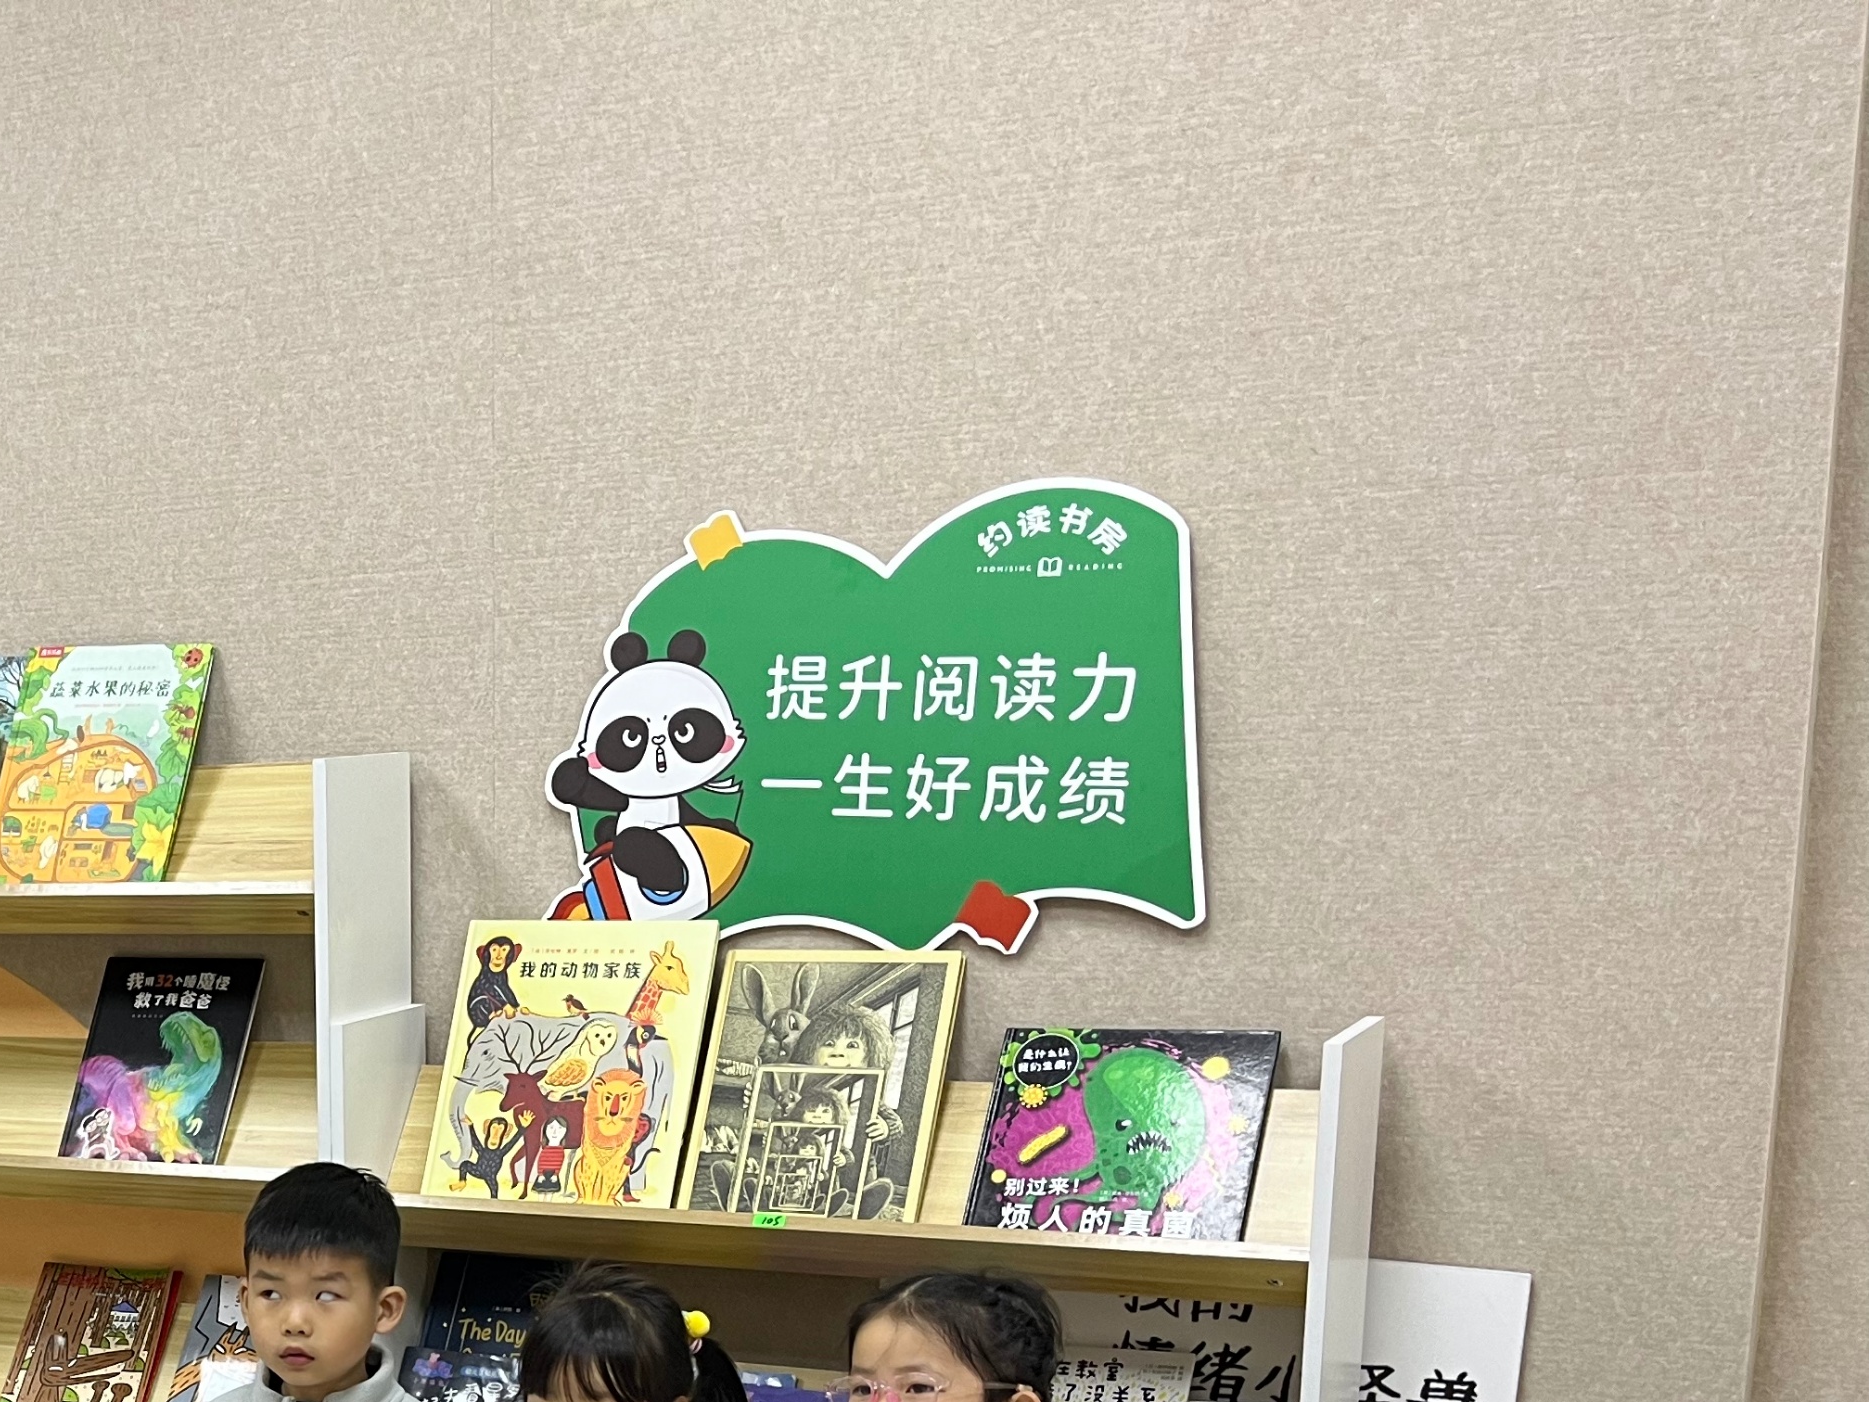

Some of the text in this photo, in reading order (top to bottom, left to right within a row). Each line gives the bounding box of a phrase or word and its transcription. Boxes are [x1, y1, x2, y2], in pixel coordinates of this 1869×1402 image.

[977, 502, 1128, 558] 约读书房
[976, 562, 1123, 573] PROMISING READING
[50, 680, 171, 698] 蔬菜水果的秘密
[765, 652, 1138, 723] 提升阅读力
[761, 752, 1131, 825] 一生好成绩
[520, 961, 642, 979] 我的动物家族
[133, 990, 212, 1010] 救了我爸爸
[1003, 1177, 1081, 1197] 别过来!
[762, 1215, 781, 1227] 105
[997, 1202, 1198, 1239] 烦人的真菌
[459, 1318, 527, 1349] The Day
